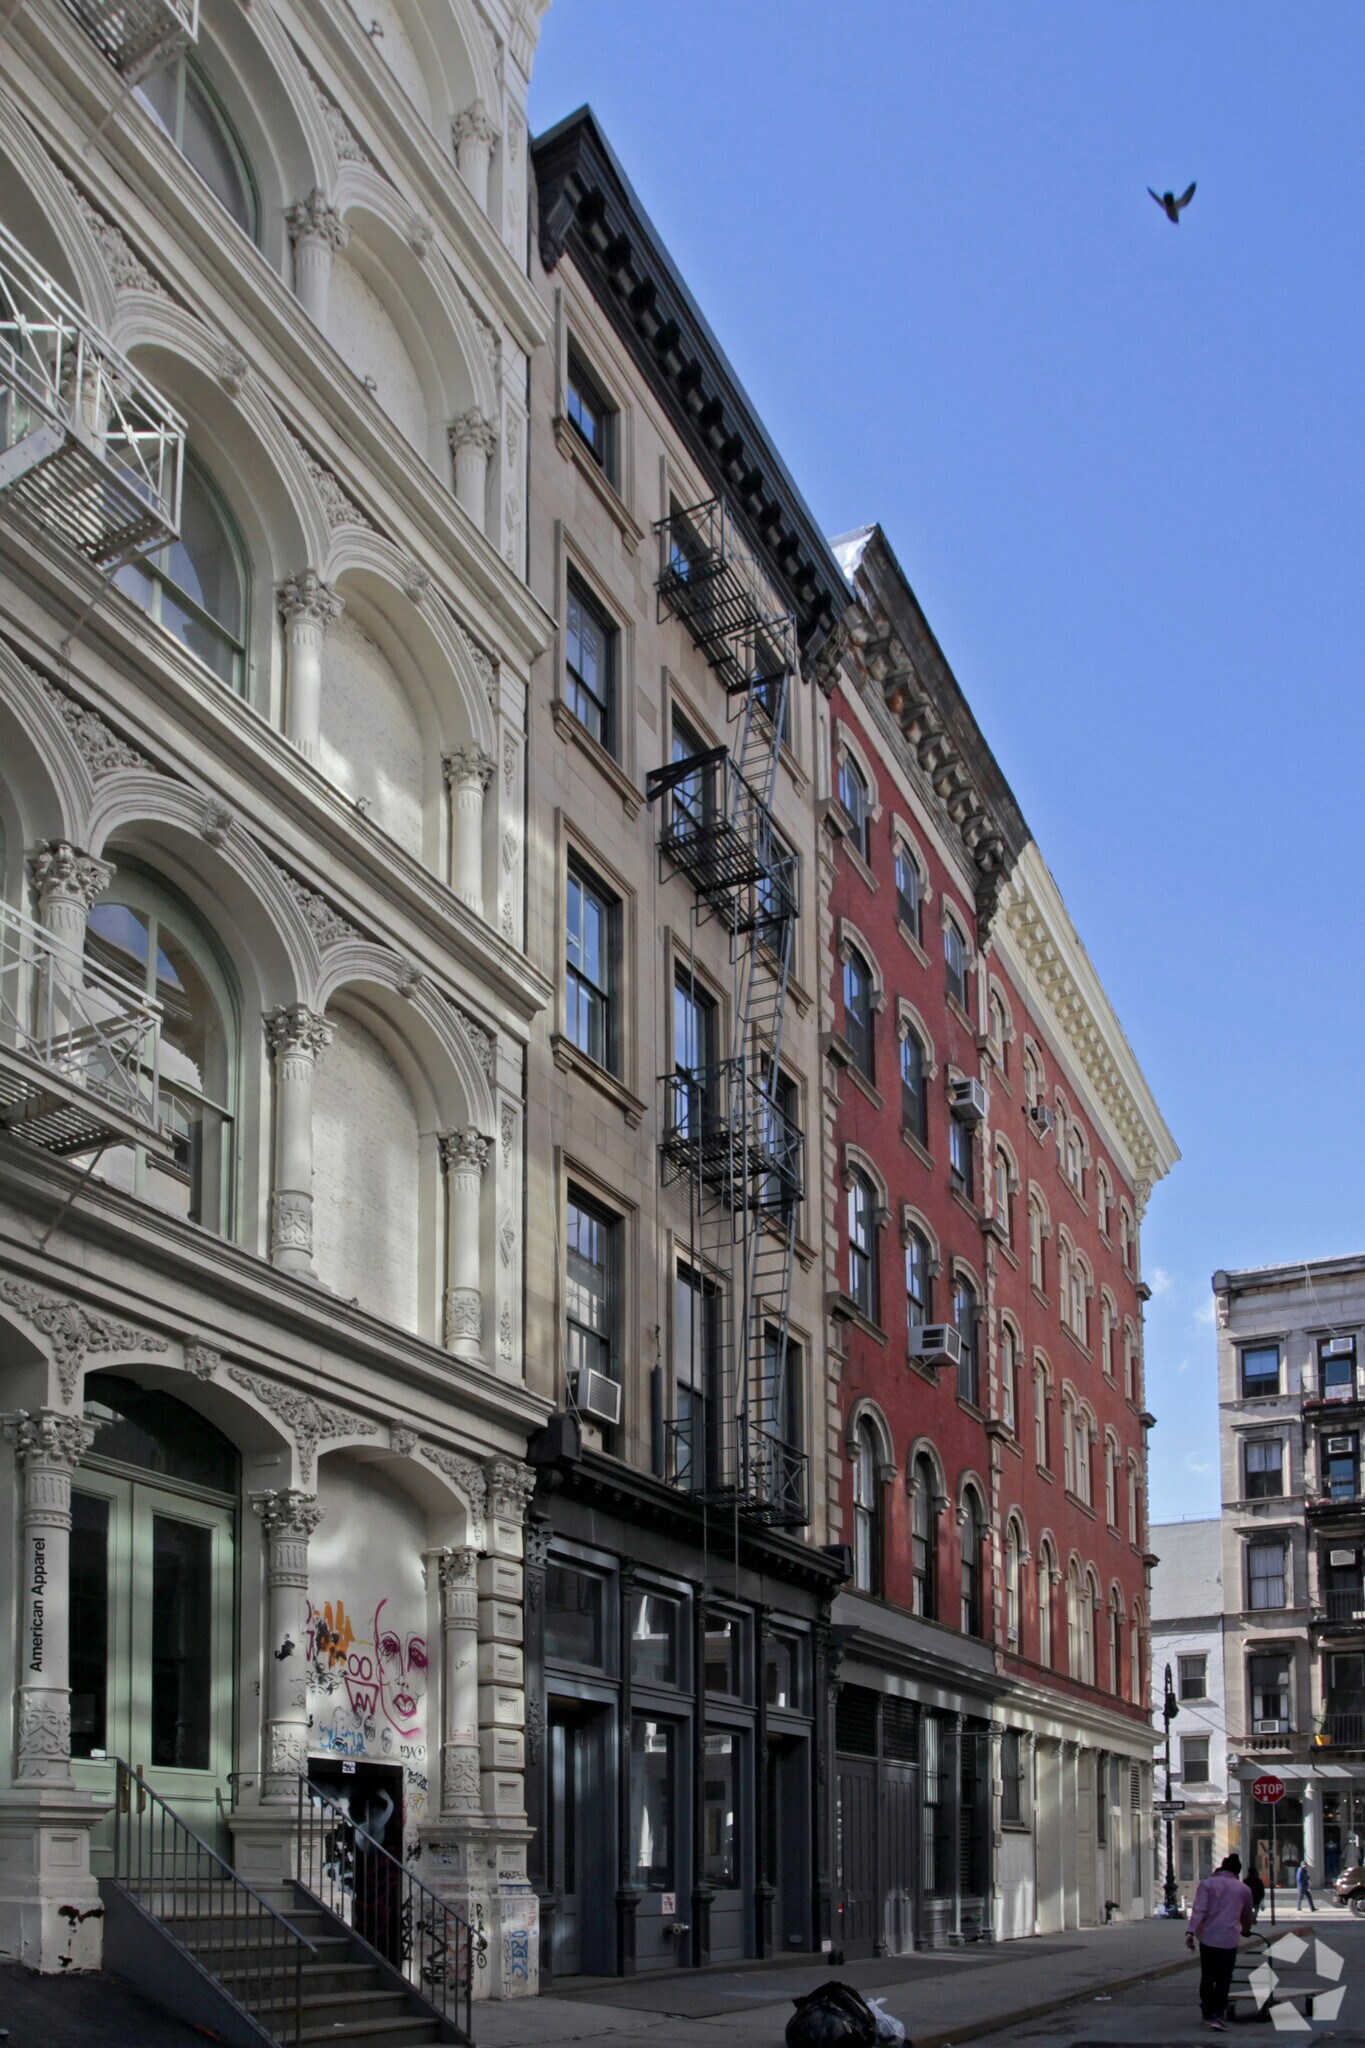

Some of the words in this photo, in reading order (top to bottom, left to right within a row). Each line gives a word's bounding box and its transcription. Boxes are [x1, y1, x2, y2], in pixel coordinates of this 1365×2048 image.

[31, 1537, 48, 1596] Apparel
[29, 1600, 44, 1673] American
[1254, 1783, 1284, 1795] STOP
